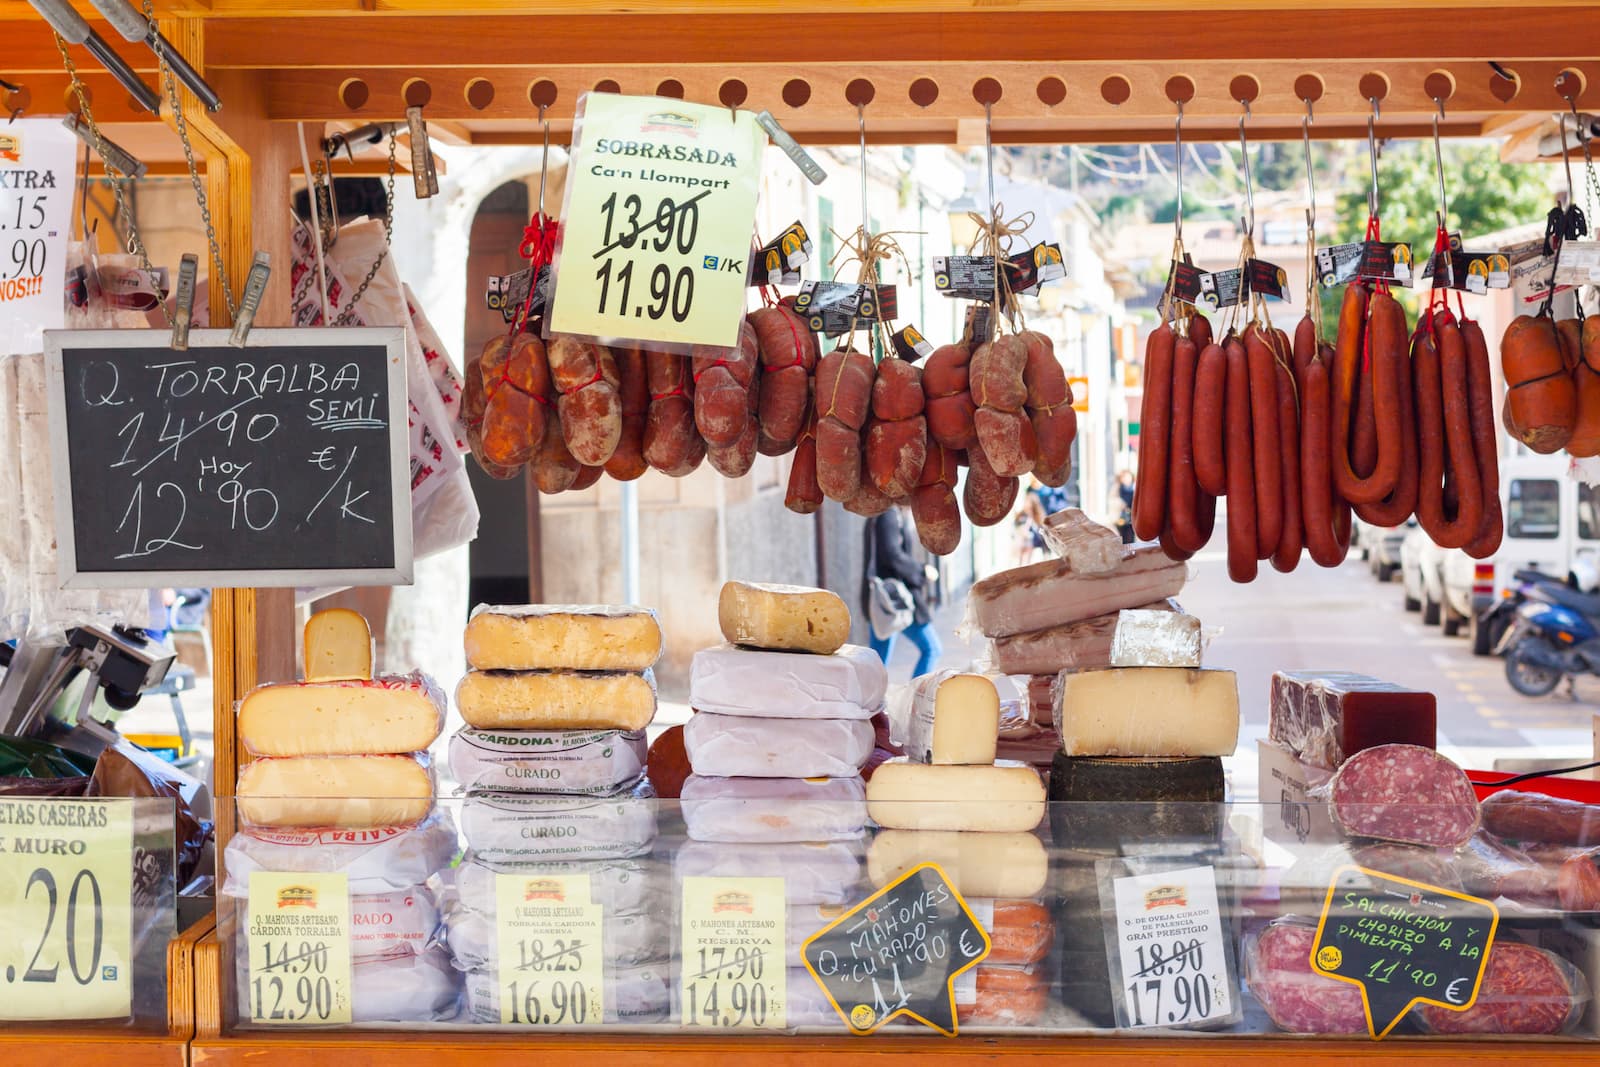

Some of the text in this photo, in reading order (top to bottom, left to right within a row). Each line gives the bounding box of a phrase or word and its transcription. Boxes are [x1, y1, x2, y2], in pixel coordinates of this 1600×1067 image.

[594, 138, 737, 168] SOBRASADA
[591, 165, 731, 189] Ca'n Llompart
[600, 192, 700, 256] 13.90
[596, 258, 695, 323] 11.90
[81, 360, 360, 407] Q. TORRALBA
[478, 733, 553, 745] CARDONA
[505, 766, 560, 780] CURADO
[39, 804, 107, 828] CASERAS
[520, 826, 577, 839] CURADO
[13, 838, 87, 856] MURO
[6, 867, 103, 985] .20
[250, 926, 342, 936] CARDONA TORRALBA
[265, 914, 299, 925] MAHONES
[301, 915, 339, 925] ARTESANO
[353, 912, 393, 925] RADO
[700, 919, 735, 928] MAHONES
[737, 919, 776, 929] ARTESANO
[850, 884, 949, 960] MAHONES
[1126, 924, 1209, 941] GRAN PRESTIGIO
[1148, 914, 1175, 923] OVEJA
[1155, 919, 1194, 929] PALENCIA
[697, 937, 772, 945] RESERVA
[958, 929, 983, 957] €
[1358, 918, 1480, 960] CHORIZO A LA
[263, 940, 328, 974] 14.90
[516, 939, 583, 972] 18.25
[698, 946, 764, 980] 17.90
[1134, 938, 1204, 978] 18.90
[252, 975, 332, 1020] 12.90
[508, 980, 587, 1024] 16.90
[686, 981, 767, 1027] 14.90
[1128, 973, 1211, 1027] 17.90
[1445, 977, 1469, 1004] €
